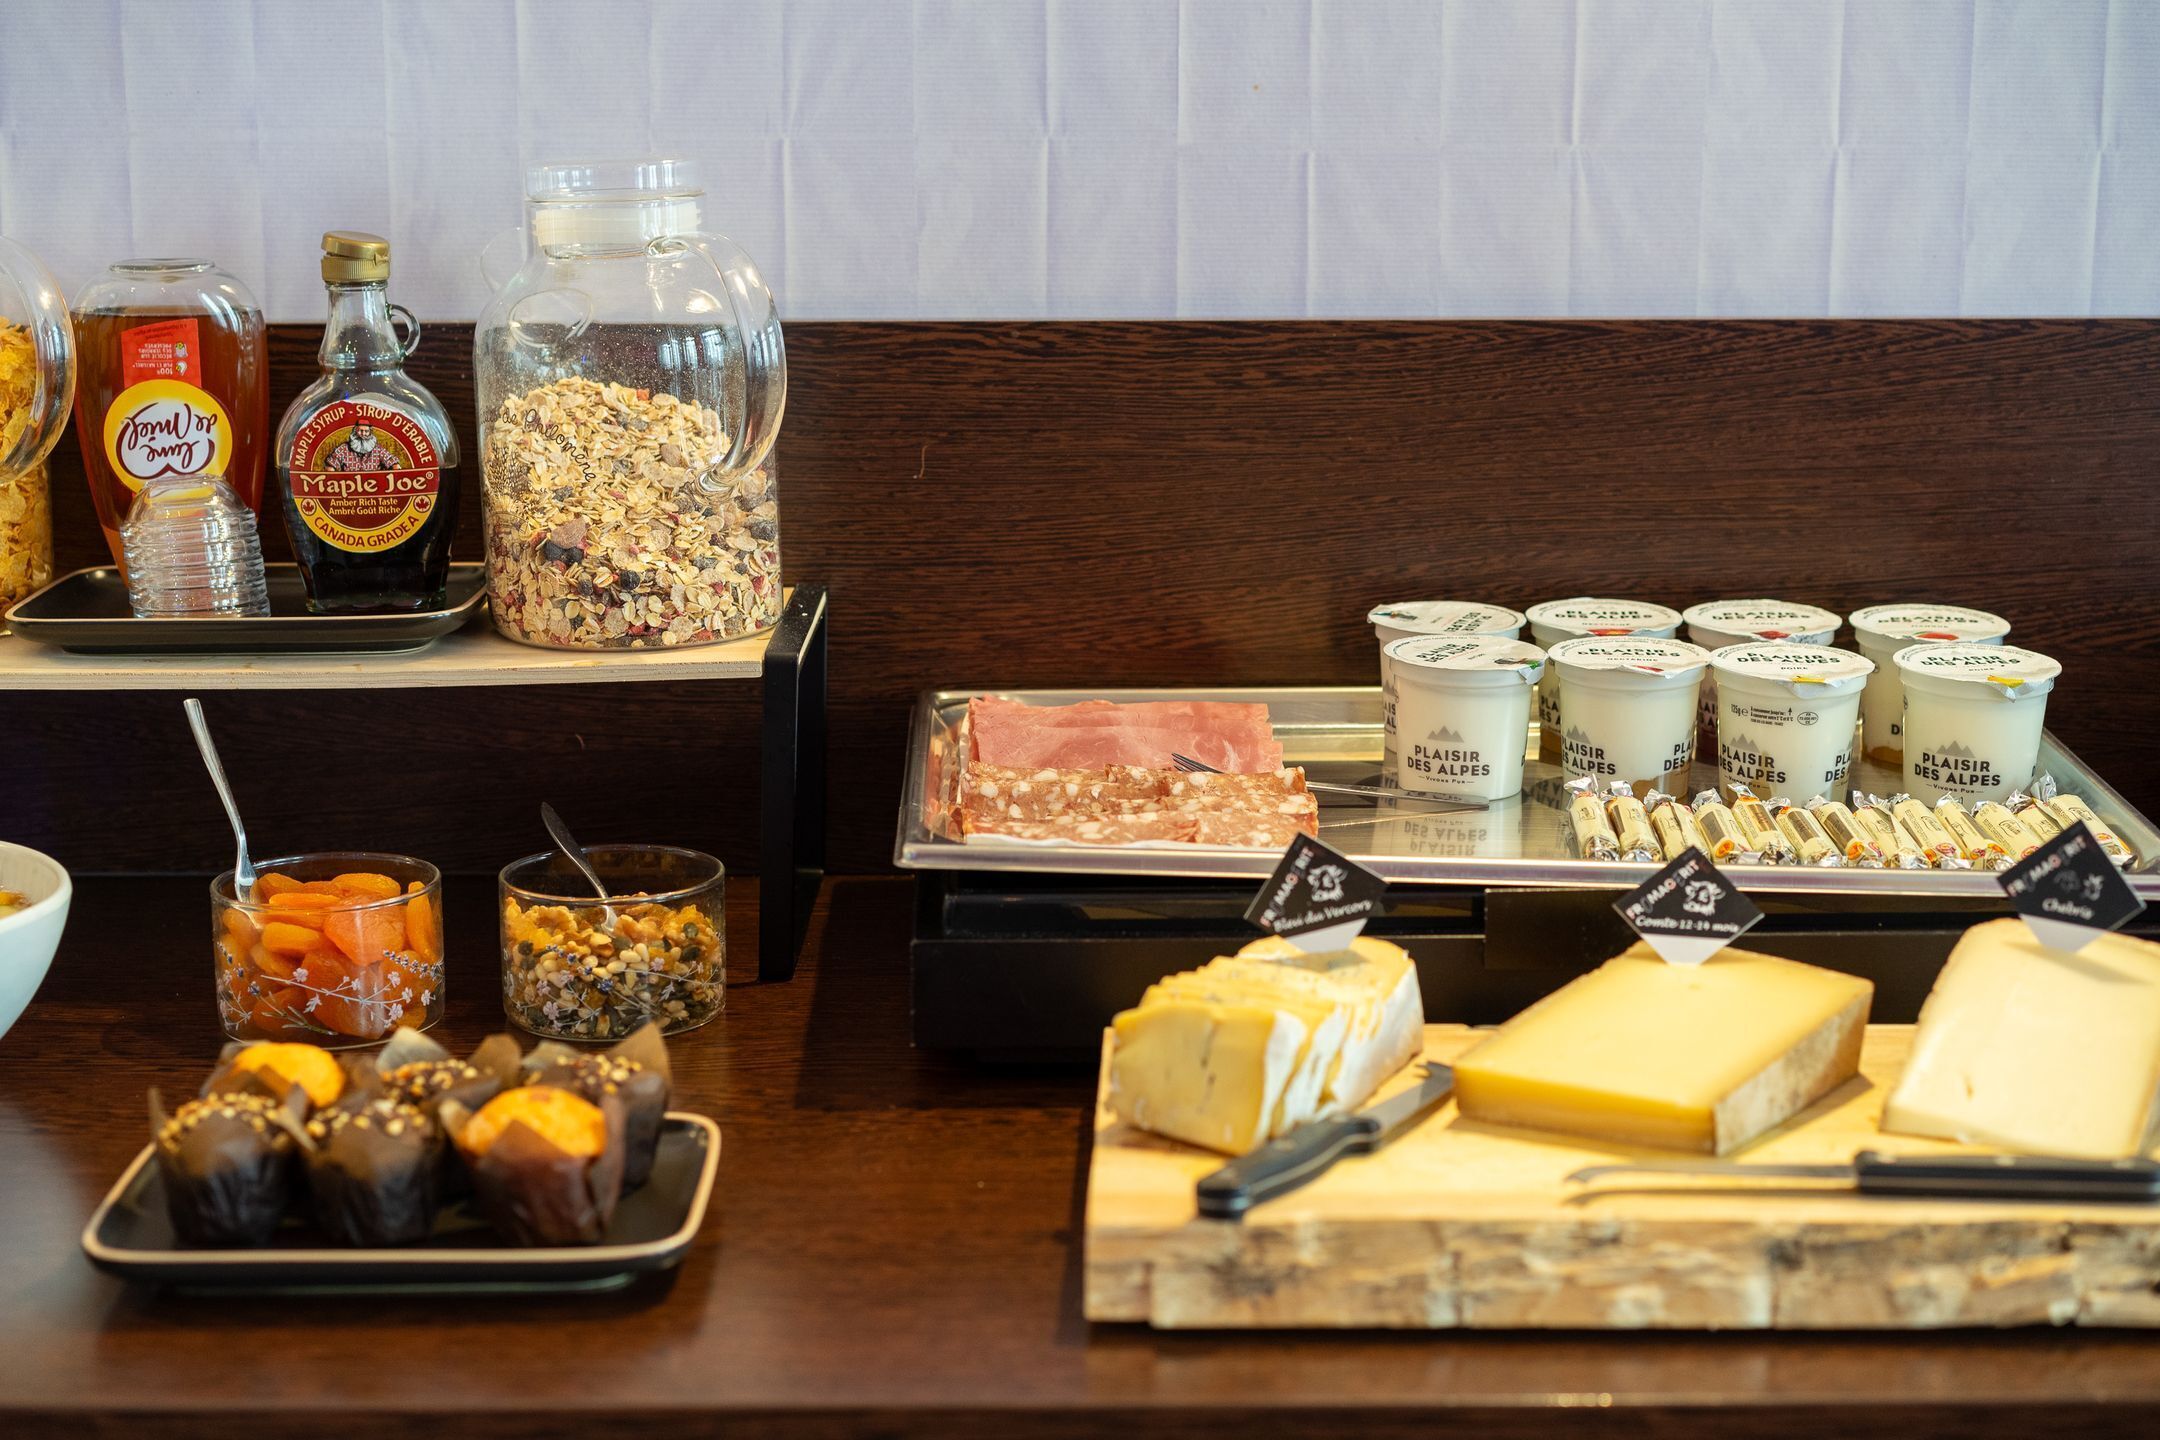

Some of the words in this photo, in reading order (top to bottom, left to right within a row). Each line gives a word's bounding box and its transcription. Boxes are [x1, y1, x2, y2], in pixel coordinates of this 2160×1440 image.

[194, 413, 218, 433] de
[295, 426, 317, 467] MAPLE
[314, 406, 346, 432] SYRUP
[356, 404, 392, 421] SIROP
[392, 415, 433, 464] D'ÉRABLE
[300, 474, 379, 498] Maple
[328, 506, 356, 515] Ambré
[356, 506, 378, 515] Goût
[378, 505, 401, 514] Riche
[329, 498, 357, 507] Amber
[358, 498, 377, 507] Rich
[378, 497, 399, 506] Taste
[314, 516, 365, 547] CANADA
[367, 524, 411, 547] GRADE
[410, 516, 420, 527] A
[1747, 652, 1823, 660] PLAISIR
[1414, 744, 1480, 763] PLAISIR
[1722, 743, 1775, 768] PLAISIR
[1922, 751, 1991, 773] PLAISIR
[1407, 756, 1432, 773] DES
[1437, 763, 1490, 776] ALPES
[1572, 756, 1616, 775] ALPES
[1664, 755, 1686, 772] DES
[1737, 765, 1786, 783] ALPES
[1825, 766, 1846, 783] DES
[1914, 763, 1940, 781] DES
[1945, 772, 2001, 786] ALPES
